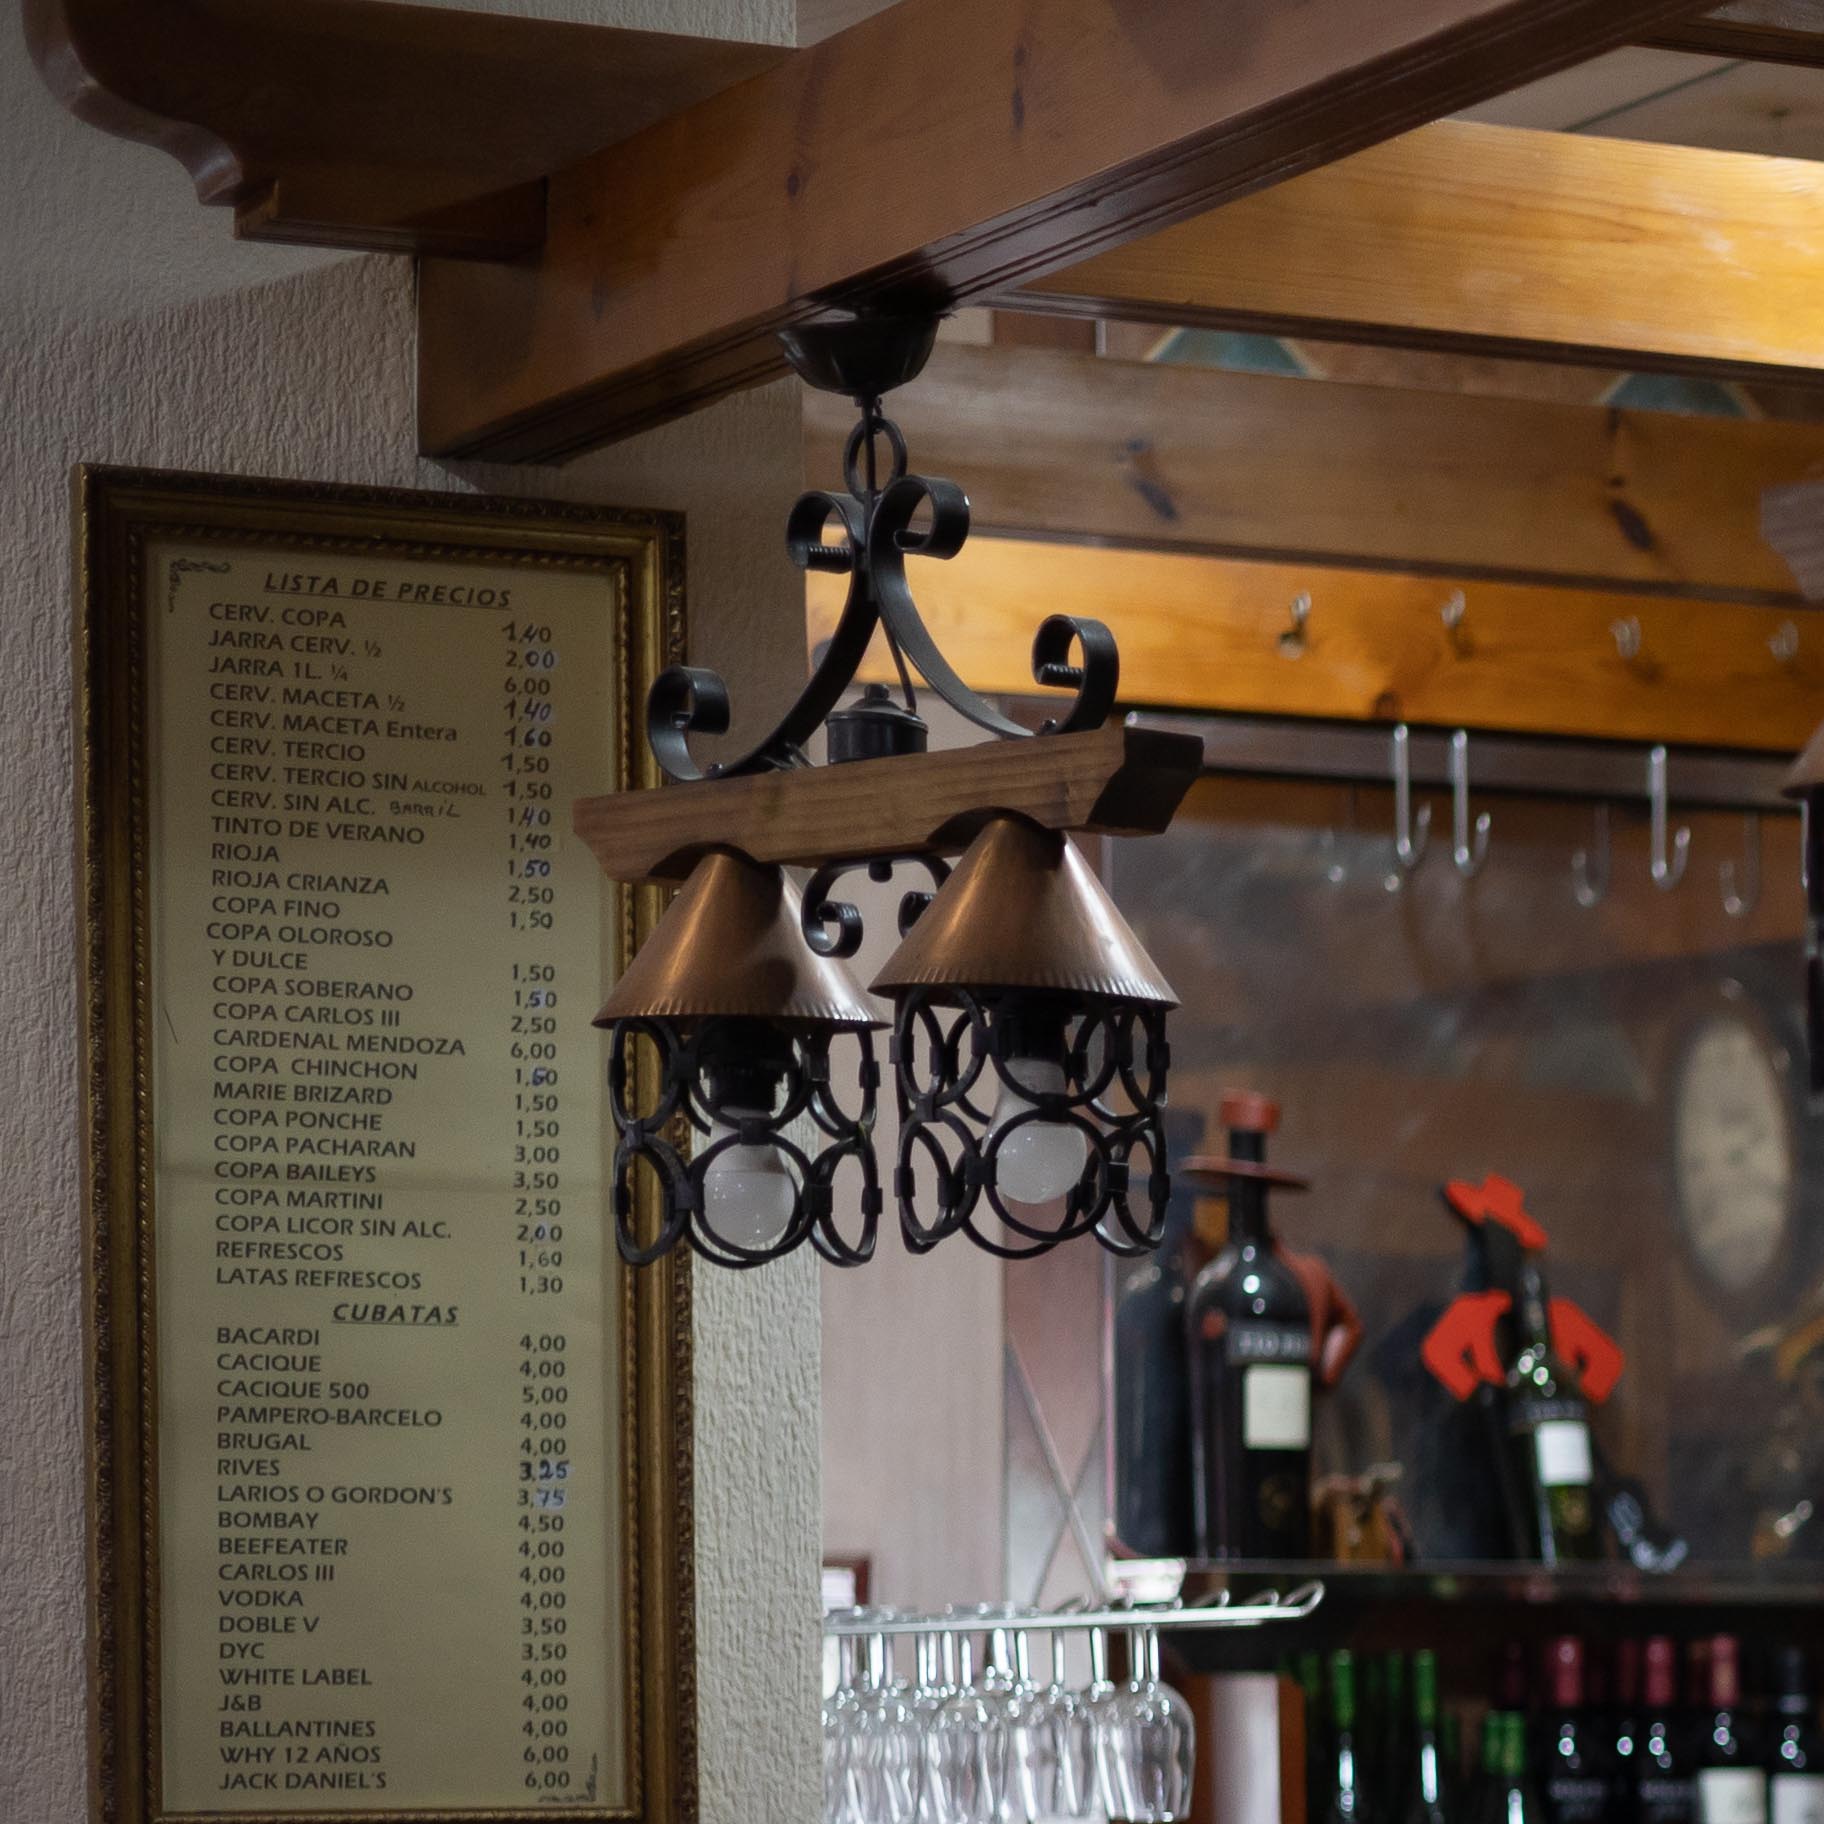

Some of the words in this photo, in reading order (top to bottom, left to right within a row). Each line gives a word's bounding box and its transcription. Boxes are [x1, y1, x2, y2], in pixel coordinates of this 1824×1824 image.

[265, 571, 339, 593] LISTA
[351, 577, 388, 596] DE
[398, 581, 512, 605] PRECIOS
[208, 601, 275, 625] CERV.
[280, 607, 347, 630] COPA
[207, 628, 285, 652] JARRA
[289, 633, 356, 658] CERV.
[207, 655, 285, 679] JARRA
[209, 681, 277, 705] CERV.
[282, 686, 381, 711] MACETA
[209, 708, 277, 732] CERV.
[282, 712, 380, 738] MACETA
[386, 718, 458, 743] Entera
[209, 734, 277, 758] CERV.
[282, 739, 366, 763] TERCIO
[210, 760, 277, 784] CERV.
[282, 766, 367, 790] TERCIO
[371, 770, 409, 793] SIN
[210, 786, 277, 811] CERV.
[283, 792, 320, 813] SIN
[324, 794, 376, 817] ALC.
[210, 814, 283, 838] TINTO
[288, 818, 321, 840] DE
[325, 821, 425, 846] VERANO
[211, 841, 281, 864] RIOJA
[211, 868, 281, 890] RIOJA
[286, 872, 390, 896] CRIANZA
[211, 894, 278, 917] COPA
[283, 898, 341, 920] FINO
[205, 921, 272, 943] COPA
[277, 924, 394, 949] OLOROSO
[211, 948, 227, 968] Y
[232, 949, 308, 972] DULCE
[212, 974, 279, 996] COPA
[284, 977, 414, 1003] SOBERANO
[212, 1001, 279, 1023] COPA
[284, 1004, 375, 1027] CARLOS
[380, 1008, 400, 1029] III
[213, 1027, 341, 1052] CARDENAL
[346, 1033, 466, 1057] MENDOZA
[213, 1054, 279, 1075] COPA
[290, 1057, 418, 1082] CHINCHON
[213, 1080, 288, 1102] MARIE
[293, 1083, 393, 1106] BRIZARD
[213, 1107, 280, 1128] COPA
[285, 1109, 383, 1133] PONCHE
[213, 1133, 280, 1155] COPA
[285, 1135, 416, 1160] PACHARAN
[213, 1159, 280, 1182] COPA
[285, 1162, 377, 1185] BAILEYS
[214, 1187, 281, 1208] COPA
[286, 1189, 383, 1212] MARTINI
[215, 1213, 281, 1235] COPA
[286, 1215, 355, 1237] LICOR
[359, 1217, 396, 1238] SIN
[401, 1219, 452, 1240] ALC.
[215, 1239, 344, 1263] REFRESCOS
[216, 1266, 289, 1288] LATAS
[295, 1268, 422, 1291] REFRESCOS
[332, 1302, 459, 1328] CUBATAS
[216, 1326, 320, 1347] BACARDI
[216, 1352, 322, 1374] CACIQUE
[216, 1378, 322, 1400] CACIQUE
[328, 1380, 370, 1402] 500
[216, 1405, 443, 1428] PAMPERO-BARCELO
[216, 1431, 313, 1452] BRUGAL
[216, 1457, 281, 1478] RIVES
[217, 1483, 300, 1504] LARIOS
[305, 1484, 325, 1504] O
[217, 1510, 320, 1531] BOMBAY
[218, 1536, 349, 1557] BEEFEATER
[217, 1562, 309, 1583] CARLOS
[314, 1563, 335, 1583] III
[217, 1588, 305, 1609] VODKA
[218, 1614, 297, 1635] DOBLE
[302, 1614, 321, 1634] V
[219, 1641, 265, 1661] DYC
[218, 1667, 296, 1687] WHITE
[301, 1666, 373, 1687] LABEL
[217, 1693, 262, 1714] J&B
[219, 1719, 376, 1740] BALLANTINES
[219, 1745, 277, 1766] WHY
[284, 1745, 309, 1765] 12
[314, 1741, 381, 1766] AÑOS
[218, 1771, 279, 1791] JACK
